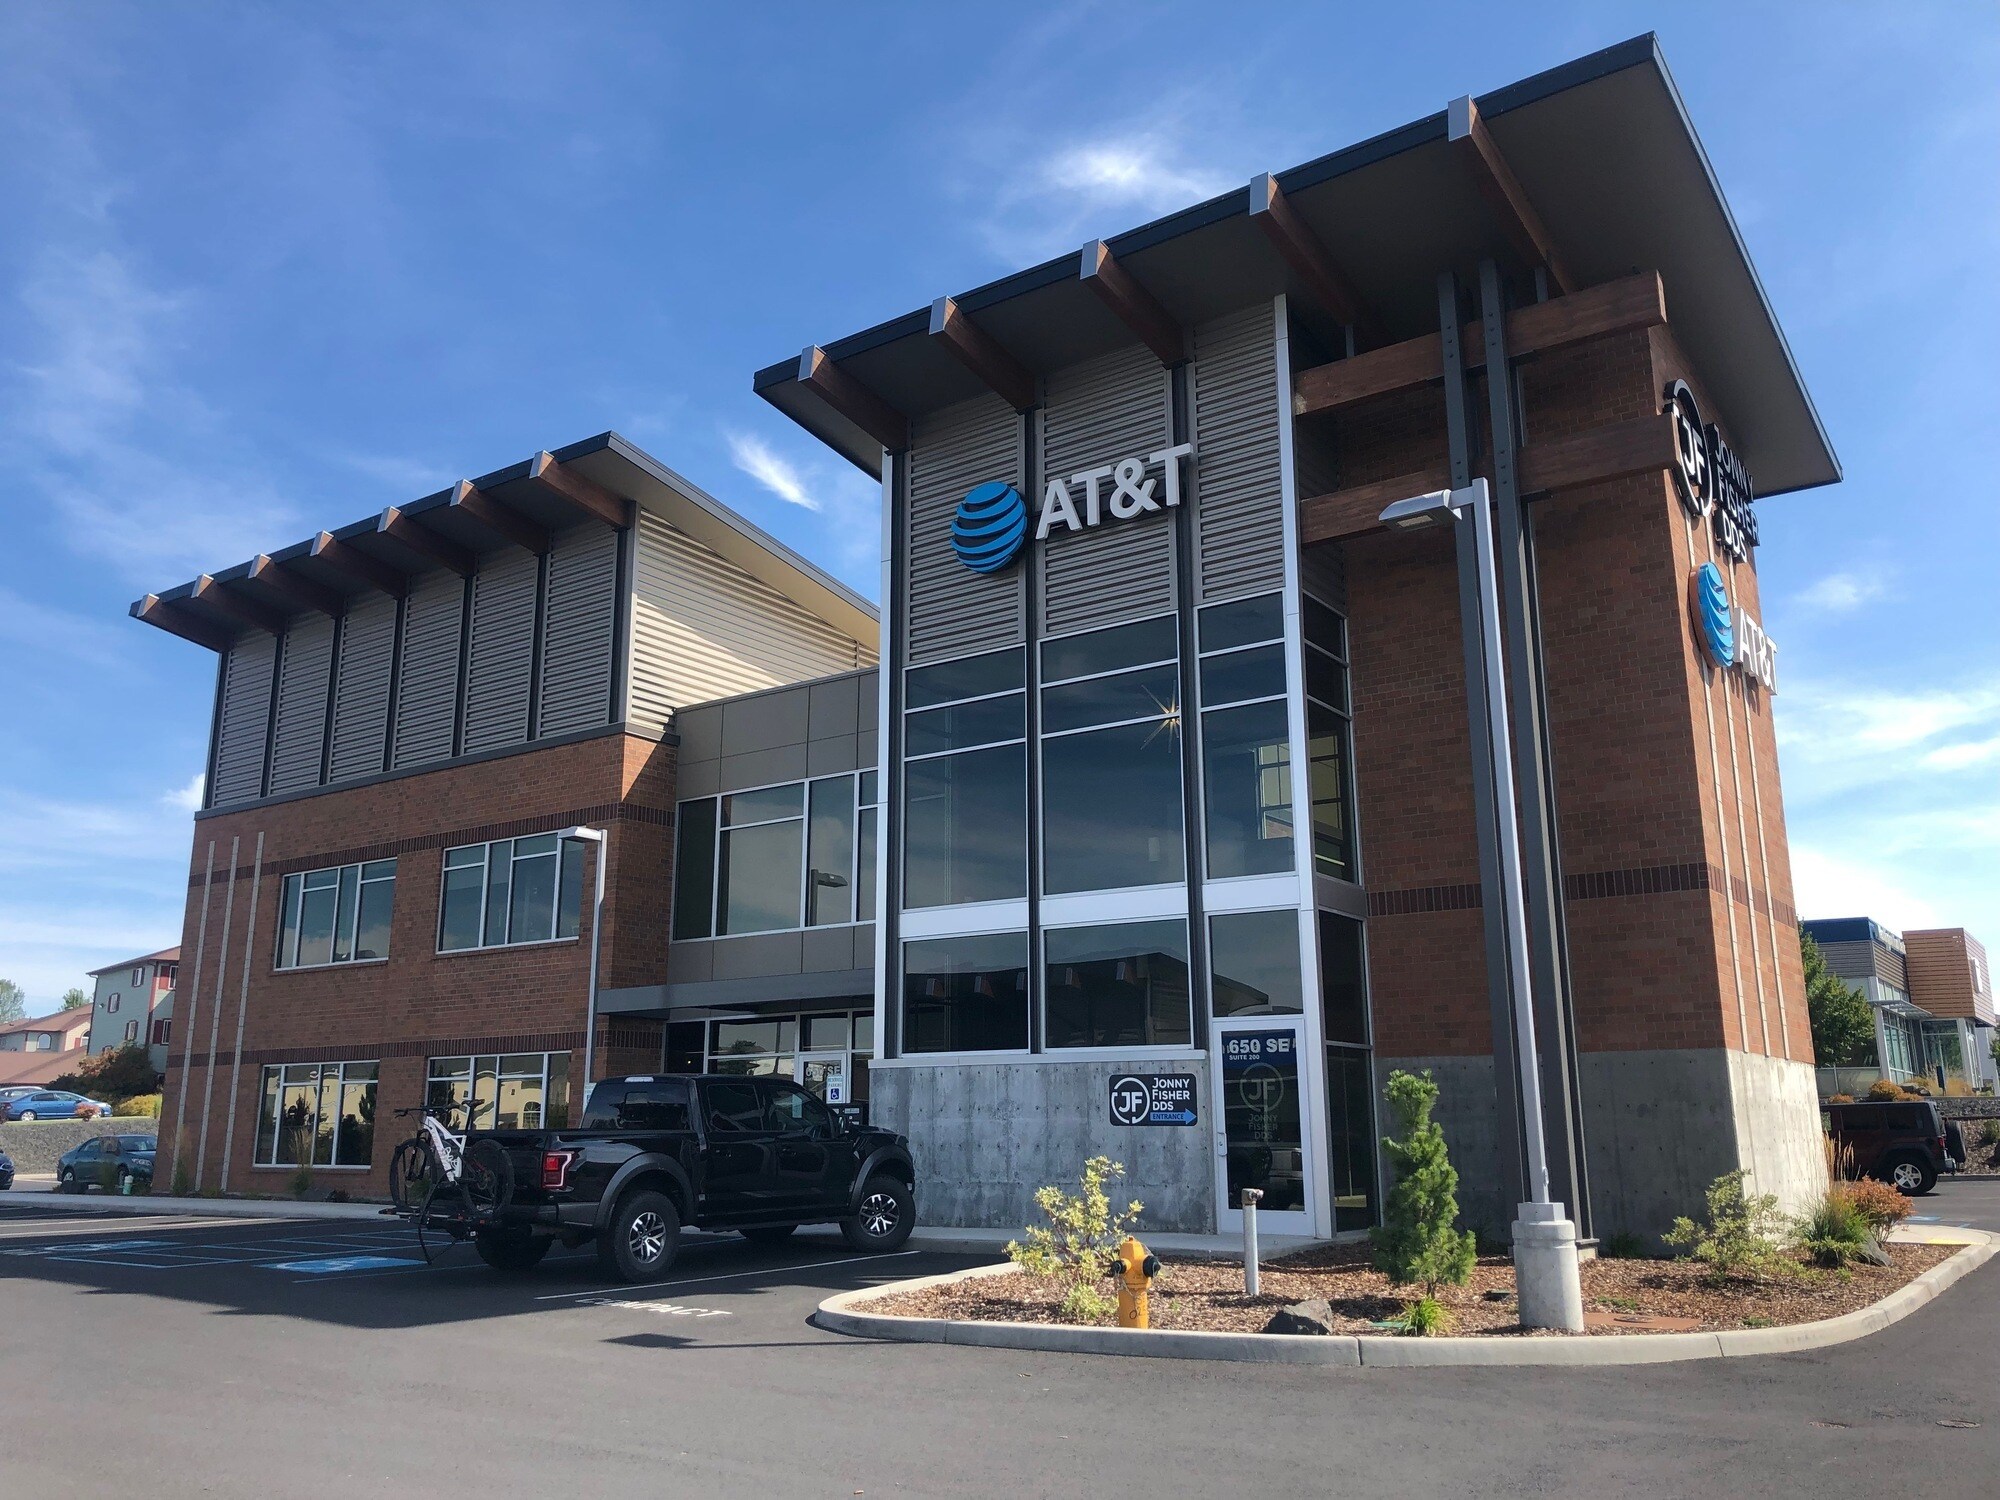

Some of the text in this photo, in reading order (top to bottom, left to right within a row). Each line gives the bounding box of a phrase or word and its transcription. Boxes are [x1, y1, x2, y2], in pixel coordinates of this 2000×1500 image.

[1714, 424, 1754, 500] JONNY
[1036, 442, 1193, 540] AT&T
[1716, 464, 1759, 541] FISHER
[1722, 509, 1748, 563] DDS
[1740, 607, 1778, 695] AT&T
[1229, 1038, 1290, 1054] 650 SE
[1118, 1091, 1143, 1113] JF
[1152, 1077, 1190, 1089] JONNY
[1152, 1089, 1190, 1100] FISHER
[1152, 1101, 1174, 1111] DDS
